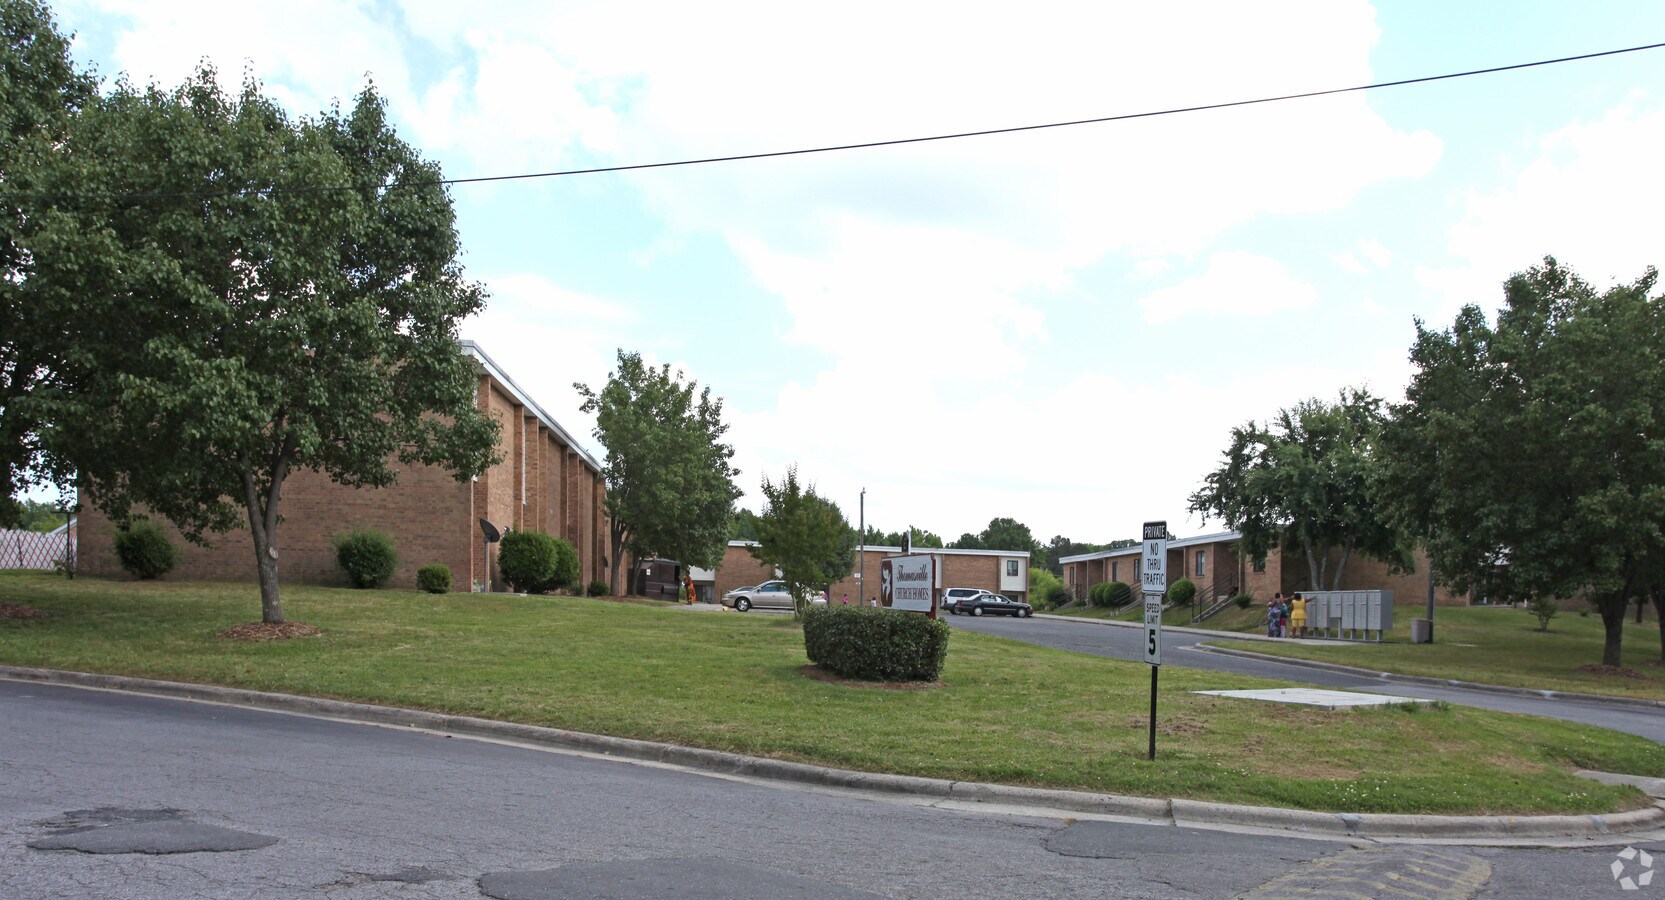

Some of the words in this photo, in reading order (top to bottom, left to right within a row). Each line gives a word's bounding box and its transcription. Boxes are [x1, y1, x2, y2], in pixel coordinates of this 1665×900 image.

[1144, 525, 1165, 538] PRIVATE
[1150, 542, 1159, 556] NO
[1147, 558, 1161, 571] THRU
[896, 564, 928, 582] Thomasville
[1144, 573, 1164, 586] TRAFFIC
[895, 588, 912, 600] CHURCH
[912, 588, 929, 600] HOMES
[1146, 603, 1160, 613] SPEED
[1146, 614, 1158, 625] LIMIT
[1148, 629, 1156, 656] 5
